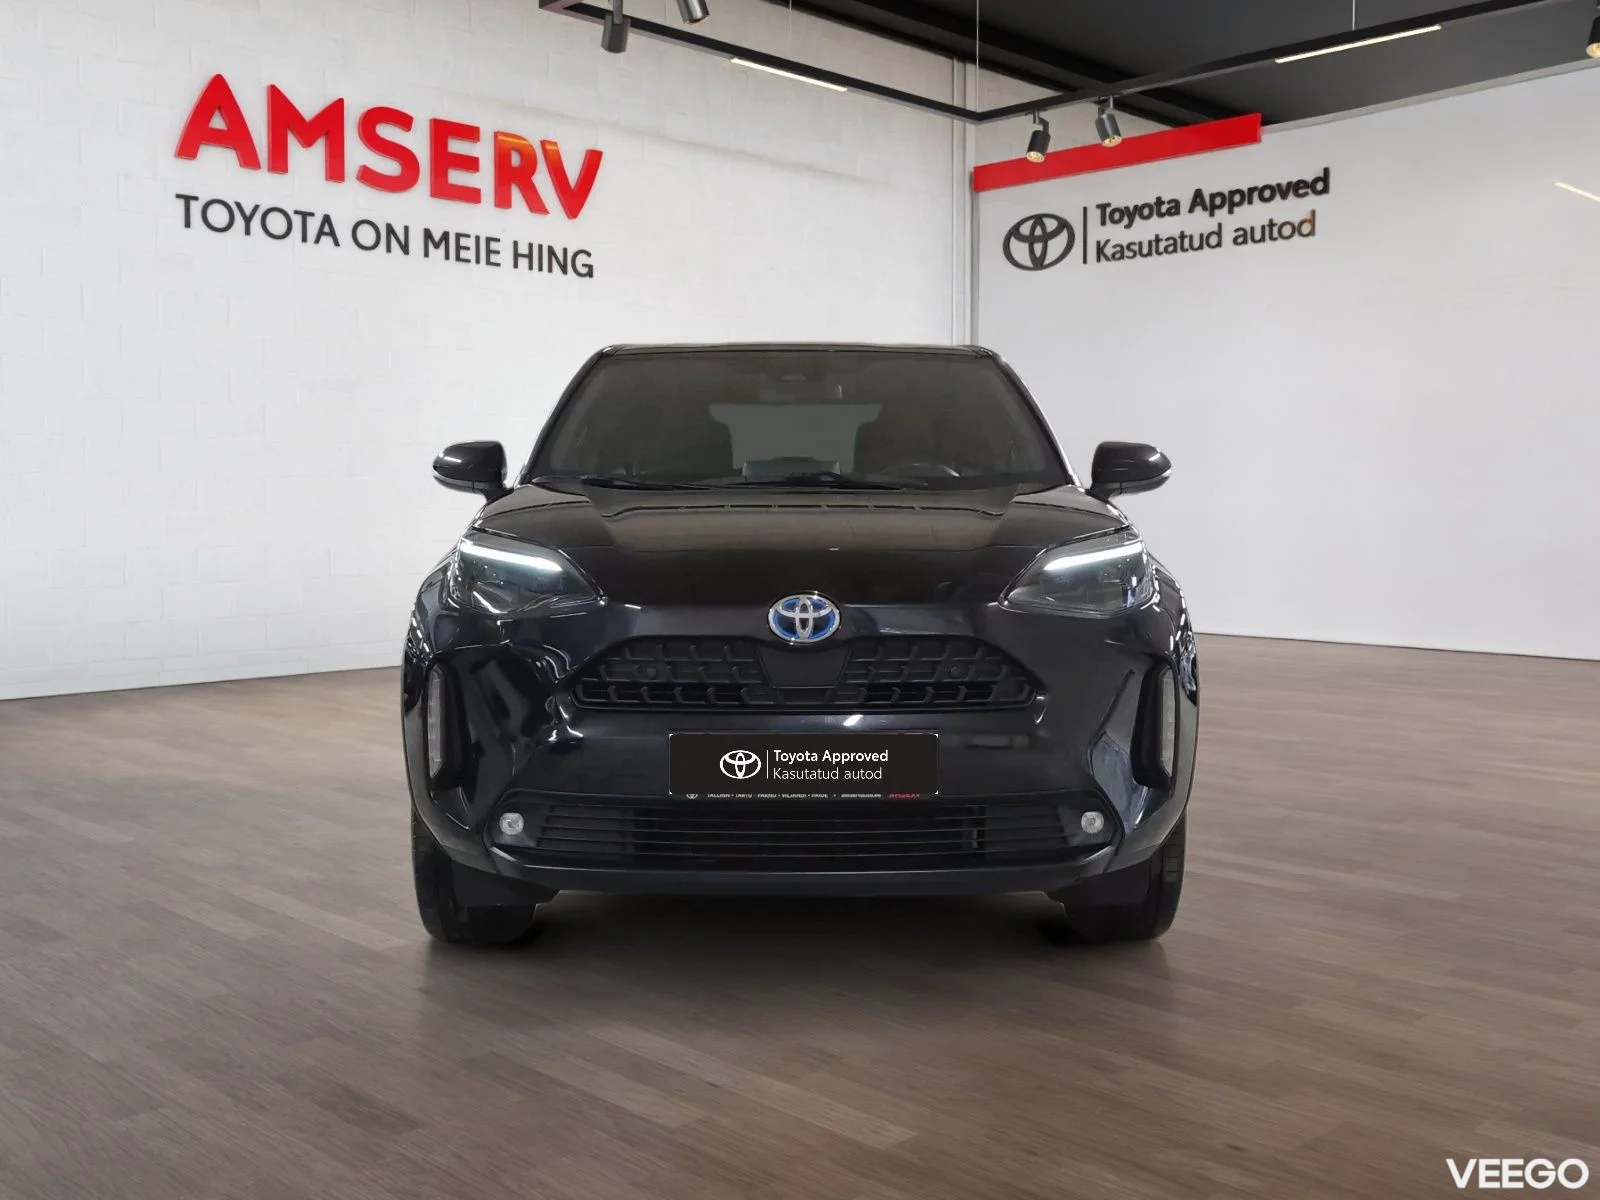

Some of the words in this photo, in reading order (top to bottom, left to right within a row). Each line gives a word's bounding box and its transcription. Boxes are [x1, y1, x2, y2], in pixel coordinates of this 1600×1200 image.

[174, 73, 604, 221] AMSERV
[1095, 195, 1181, 230] Toyota
[1187, 166, 1331, 218] Approved
[175, 193, 341, 247] TOYOTA
[351, 219, 410, 256] ON
[423, 227, 501, 267] MEIE
[513, 240, 594, 279] HING
[1095, 222, 1223, 263] Kasutatud
[1232, 209, 1316, 246] autod
[773, 750, 819, 765] Toyota
[821, 750, 889, 765] Approved
[773, 767, 839, 780] Kasutatud
[843, 767, 882, 780] autod
